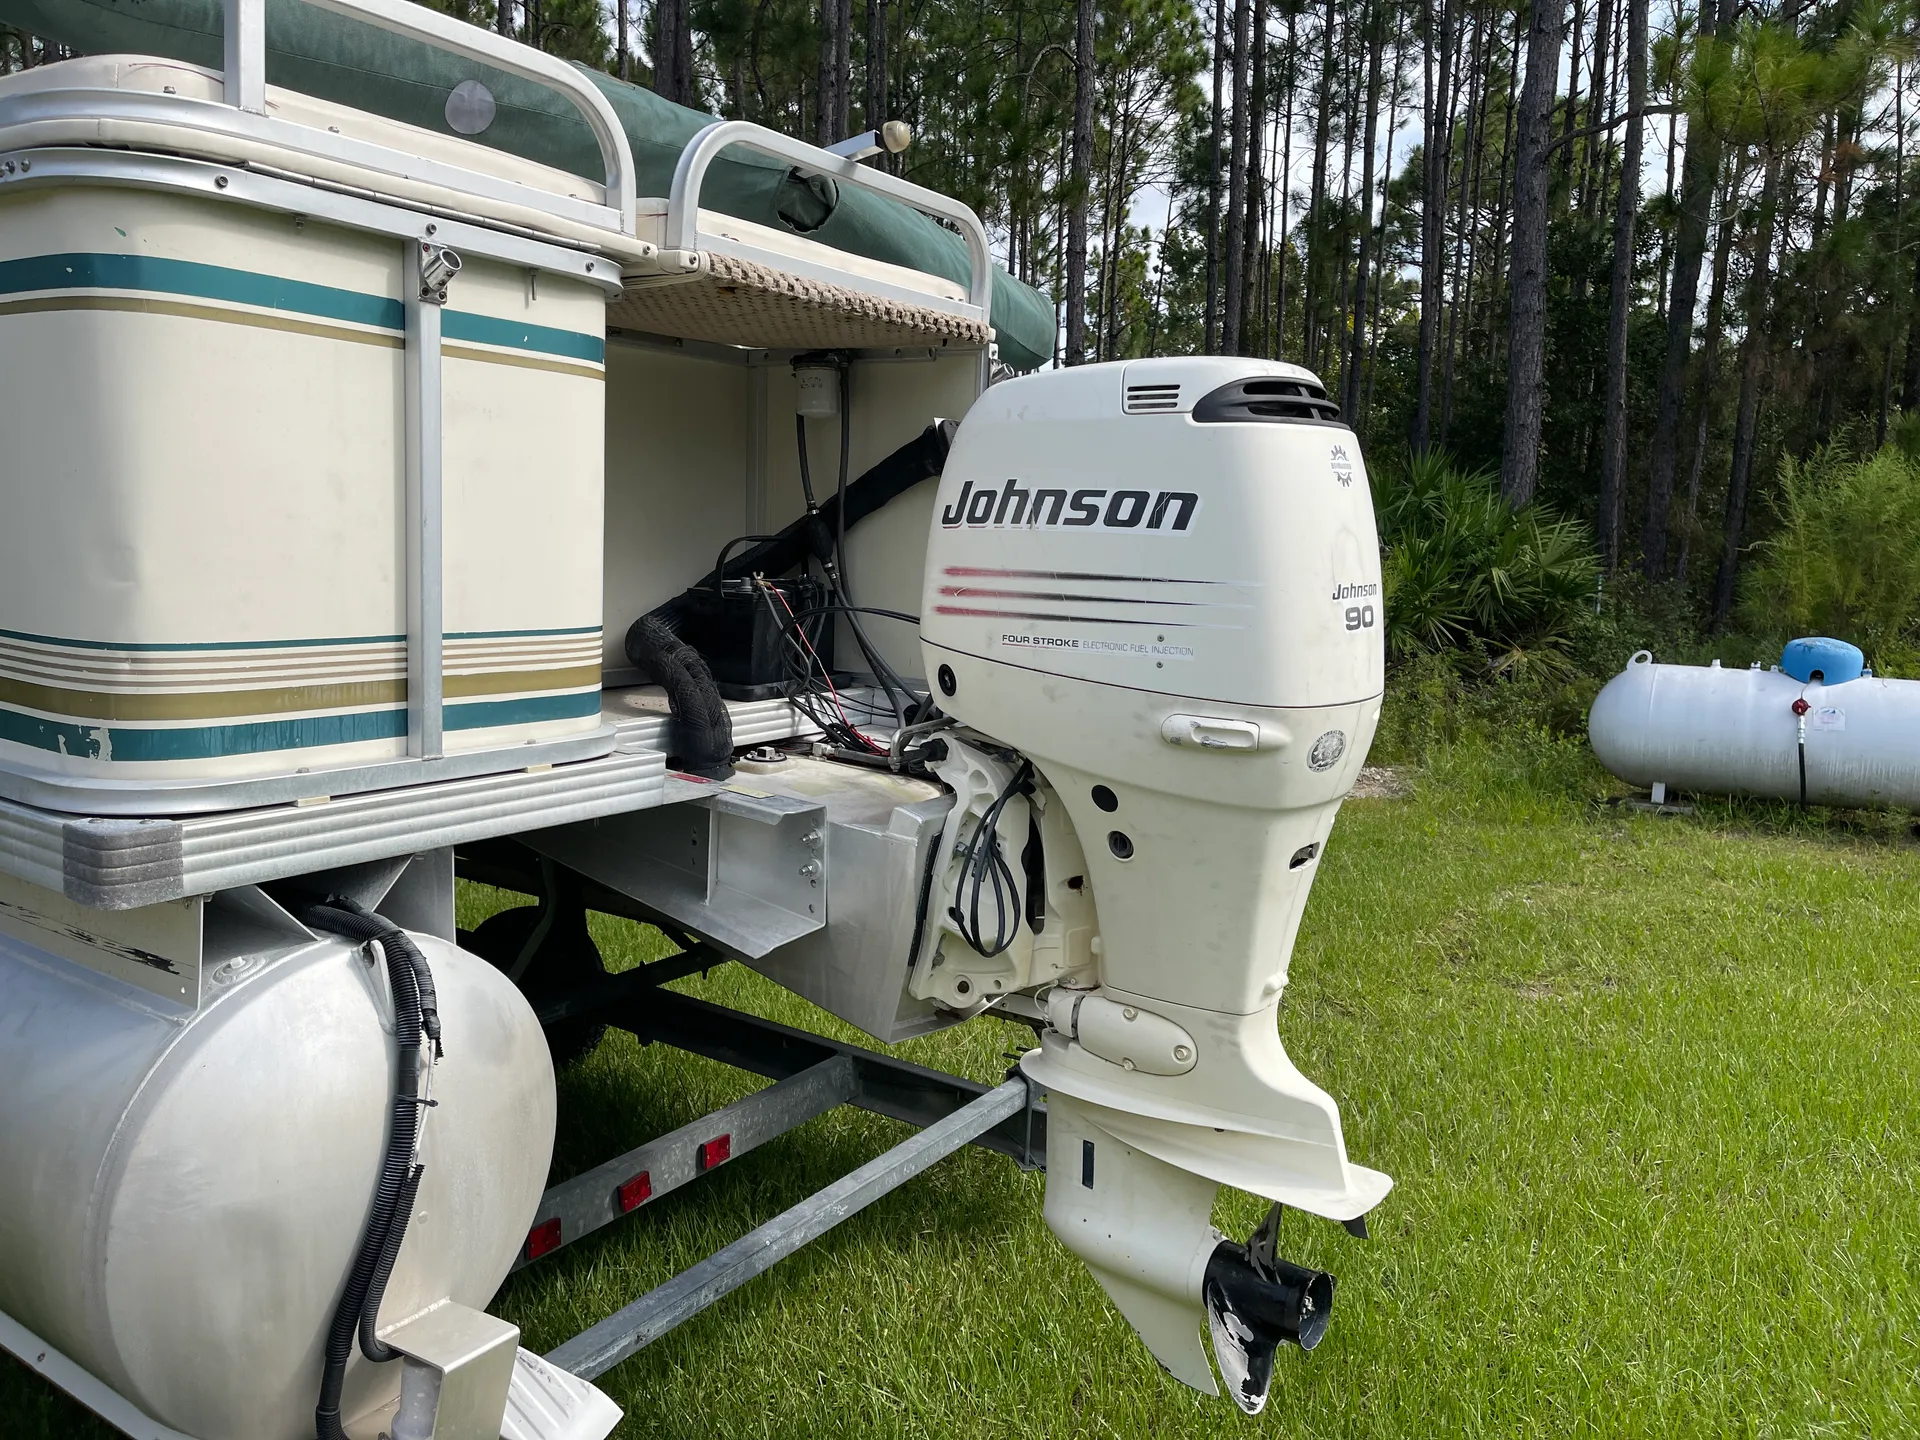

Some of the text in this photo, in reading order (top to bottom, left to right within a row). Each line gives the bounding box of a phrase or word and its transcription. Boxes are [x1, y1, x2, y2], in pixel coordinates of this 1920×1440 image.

[941, 478, 1199, 531] Johnson
[1332, 582, 1377, 600] Johnson
[1345, 605, 1374, 631] 90
[1002, 634, 1194, 656] FOUR STROKE ELECTRONIC FUEL INJECTION
